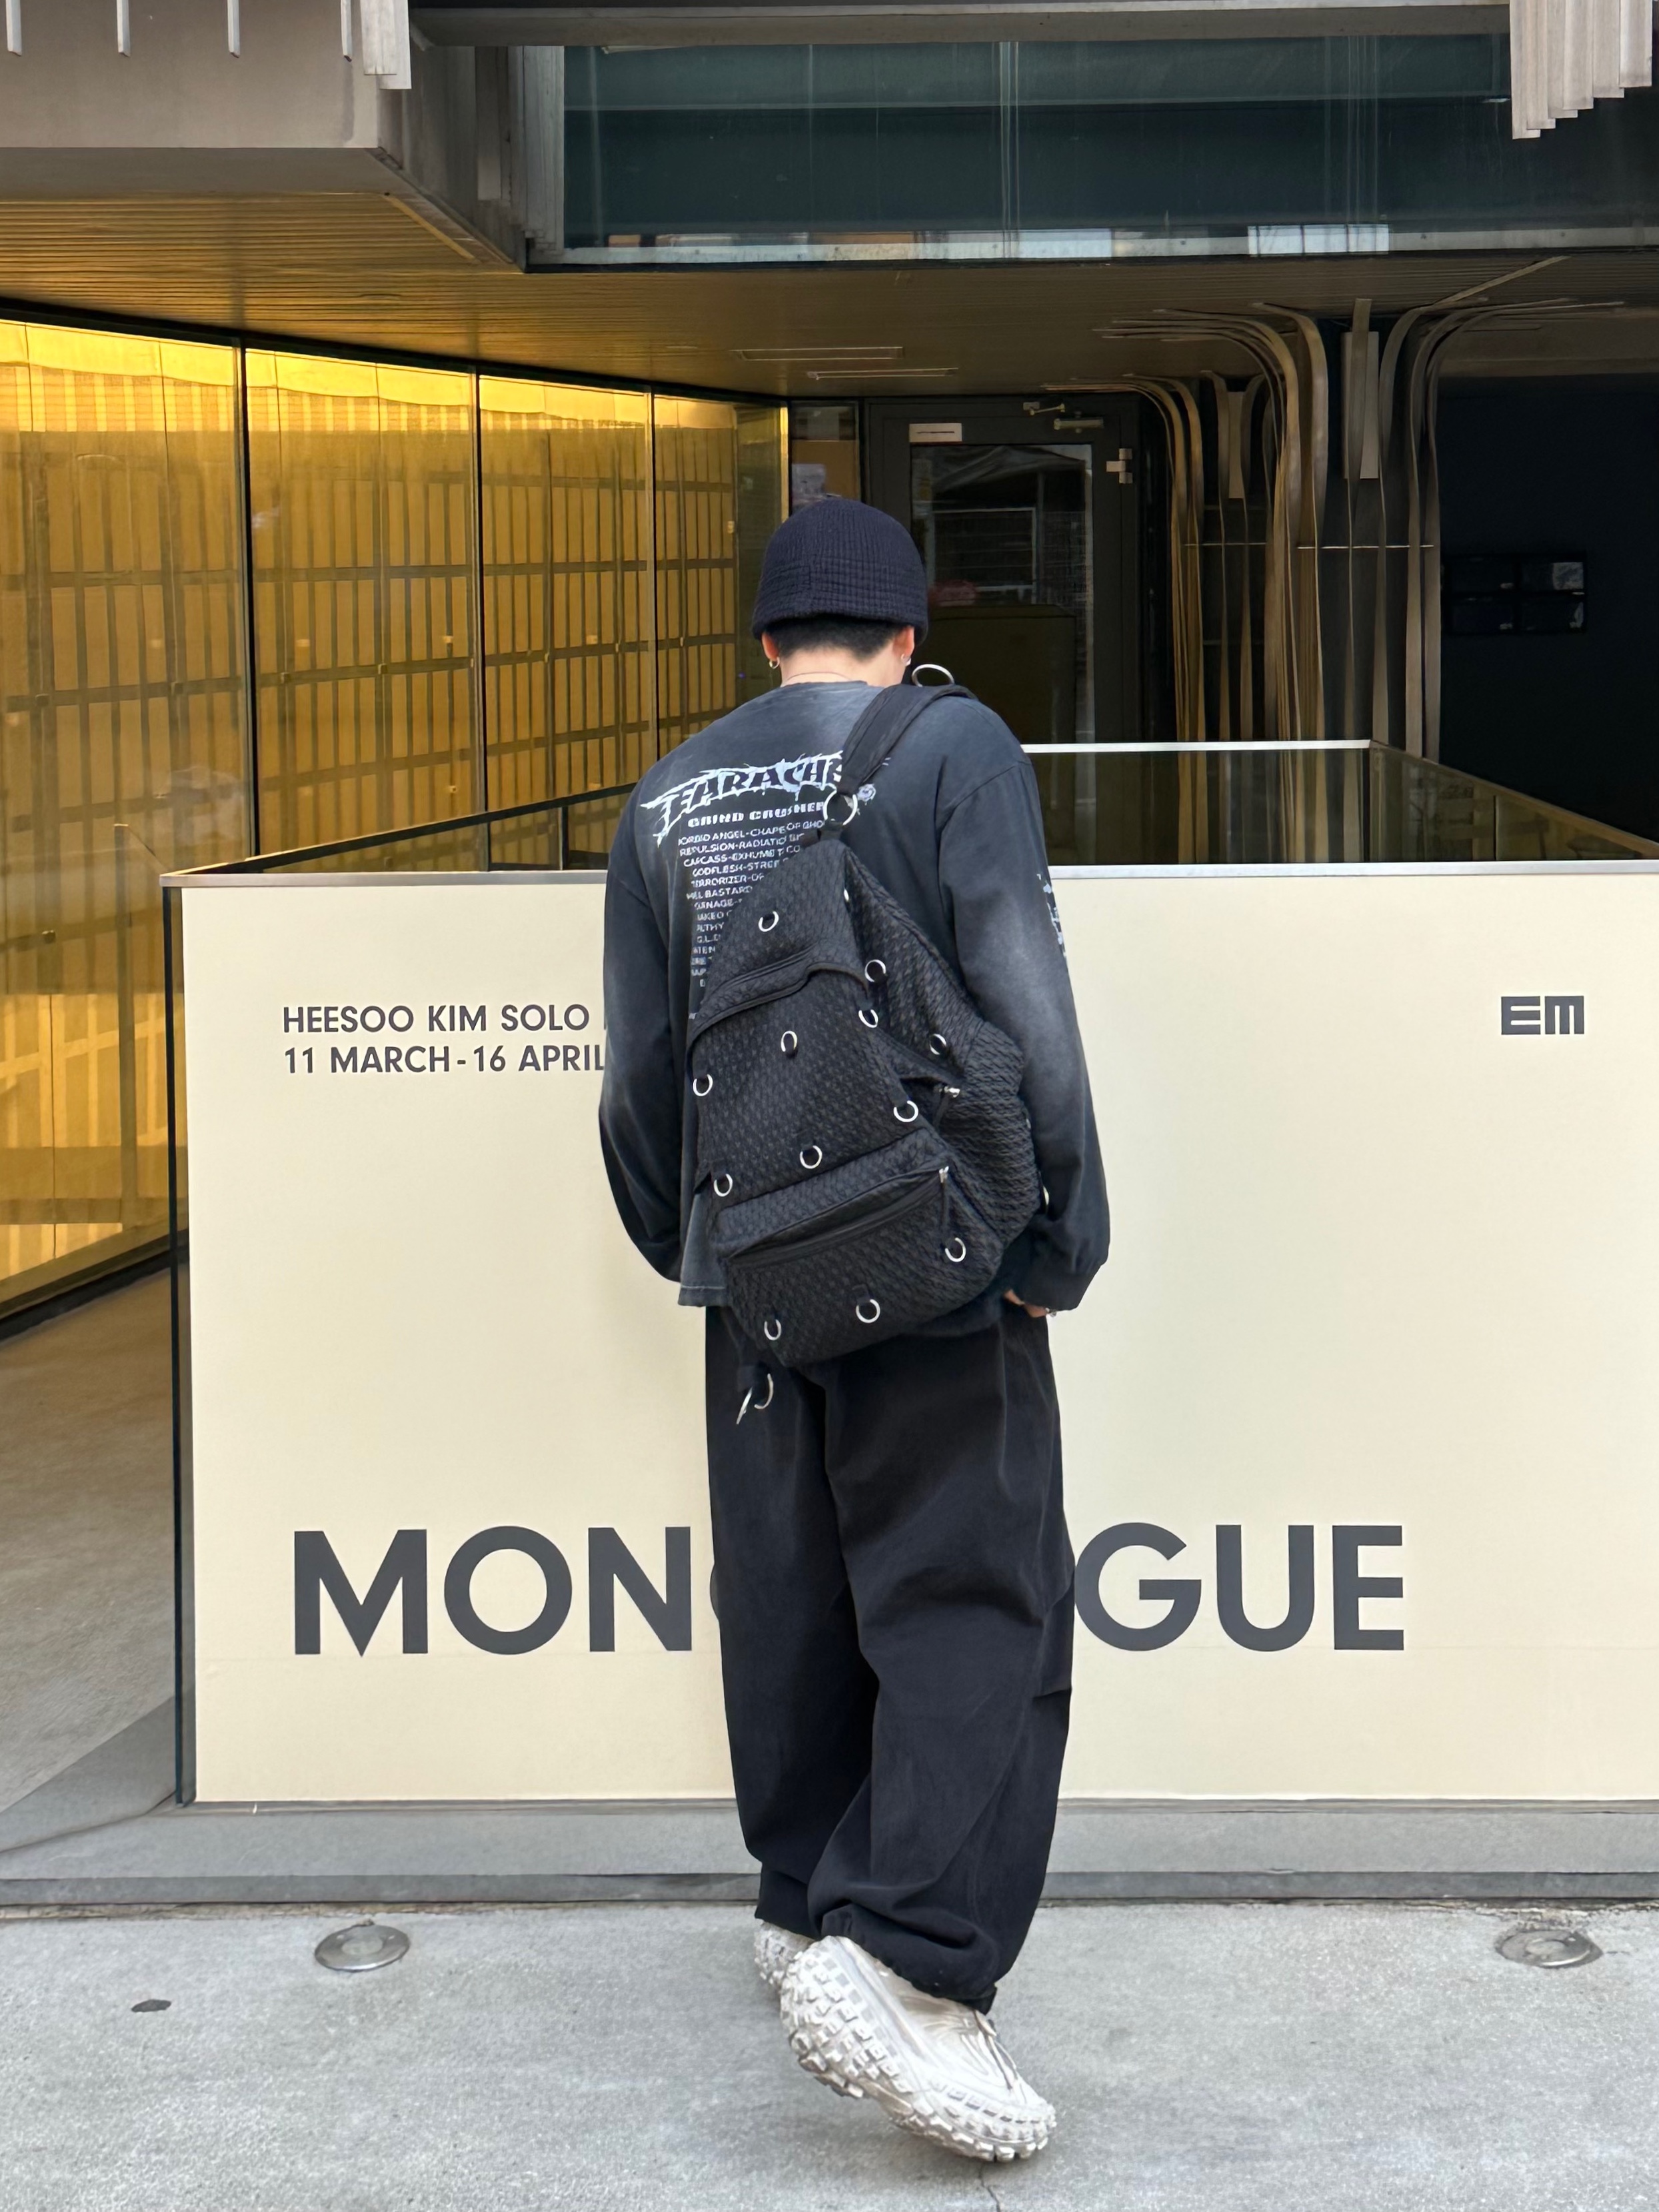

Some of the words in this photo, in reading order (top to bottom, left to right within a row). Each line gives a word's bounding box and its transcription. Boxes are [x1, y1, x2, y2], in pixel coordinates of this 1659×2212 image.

[688, 812, 745, 828] GRIND
[712, 826, 787, 841] ANGEL-CHAPE
[680, 835, 787, 856] REPULSION-RADIATIO
[284, 1006, 413, 1032] HEESOO
[429, 1006, 486, 1031] KIM
[502, 1004, 589, 1031] SOLO
[1501, 996, 1584, 1035] EM
[285, 1048, 313, 1073] 11
[519, 1045, 603, 1071] APRIL
[294, 1522, 1404, 1658] MONGUE
